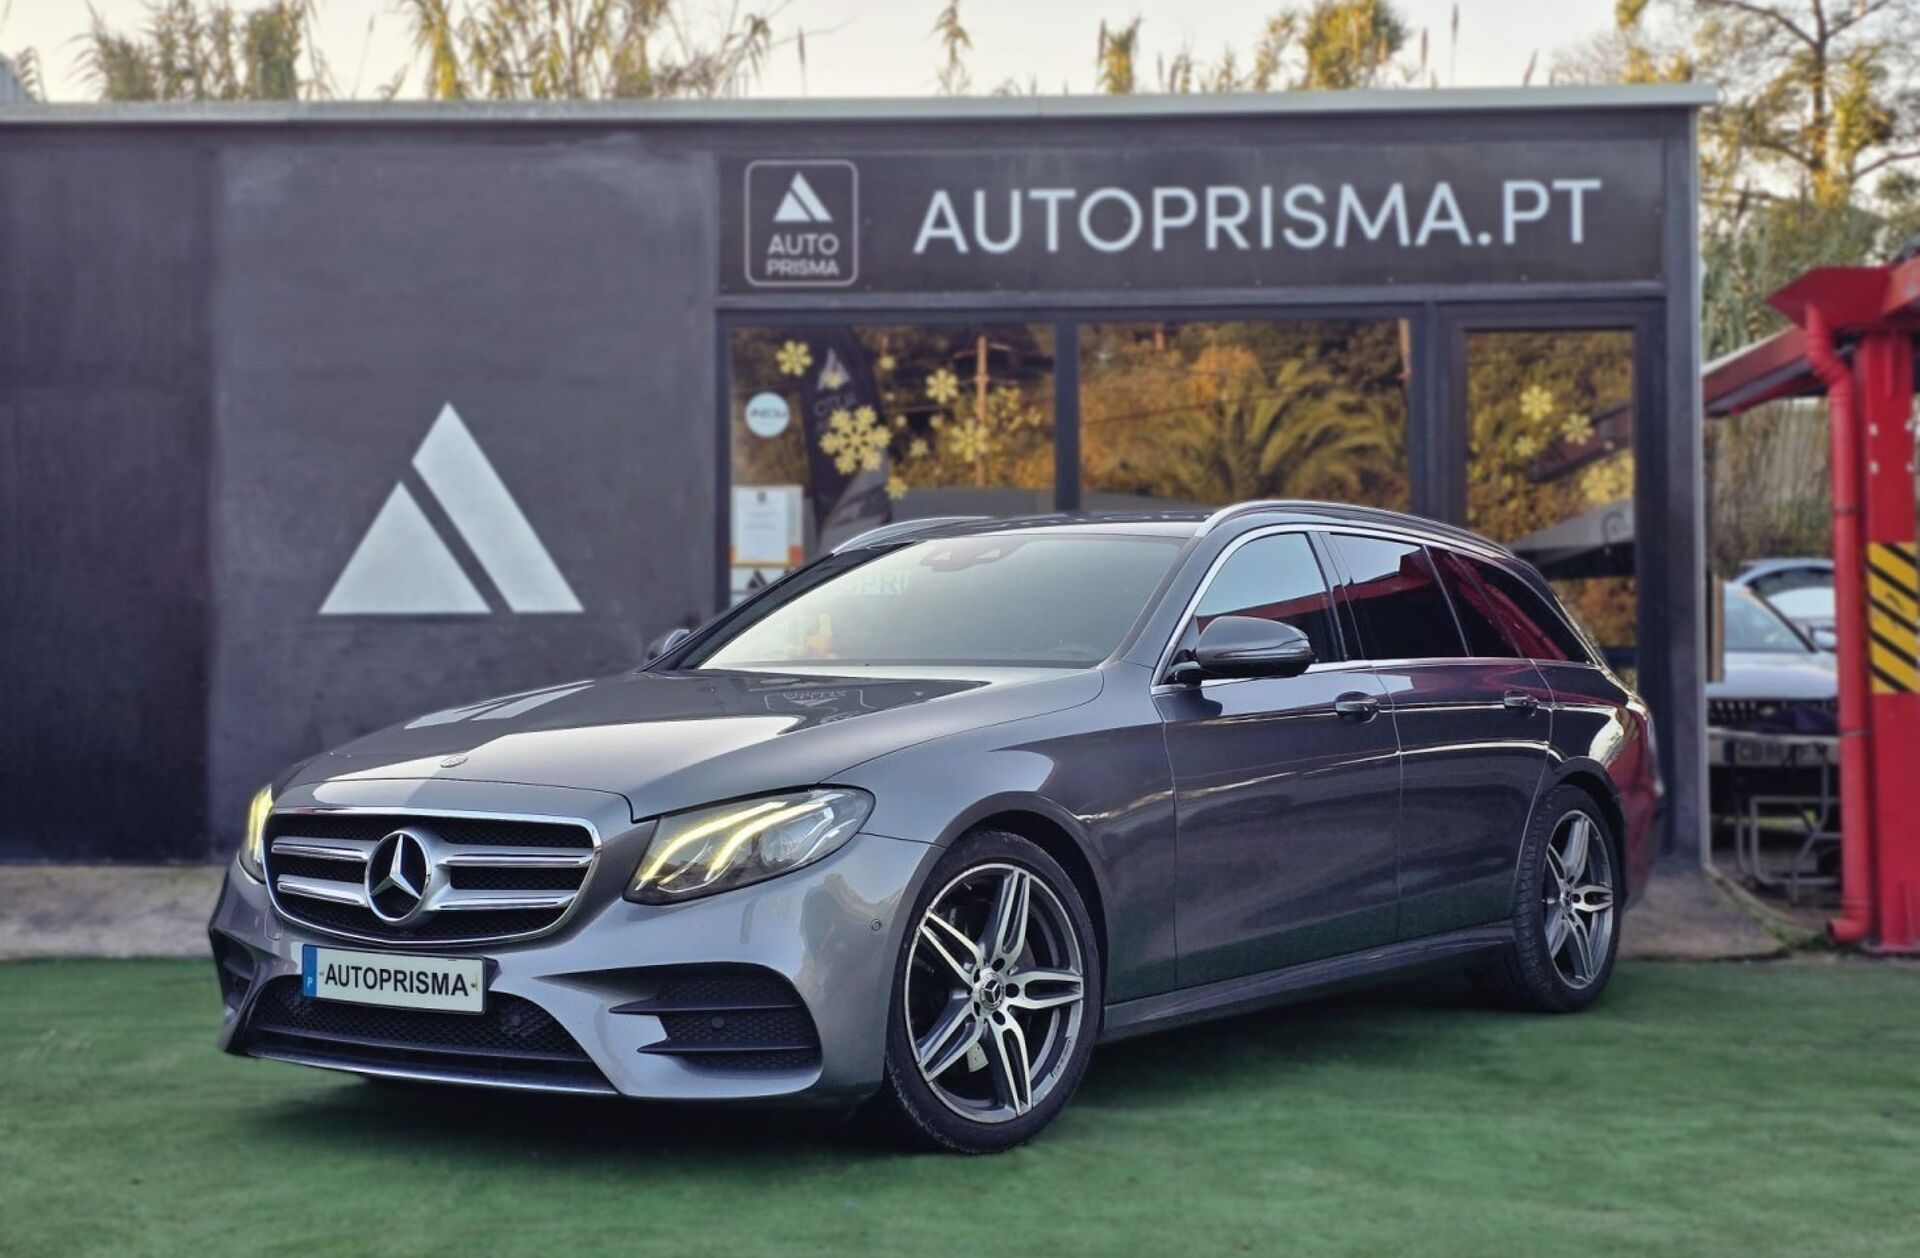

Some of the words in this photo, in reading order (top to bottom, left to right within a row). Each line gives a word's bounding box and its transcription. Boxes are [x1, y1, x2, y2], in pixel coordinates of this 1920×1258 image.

[913, 178, 1602, 253] AUTOPRISMA.PT
[767, 233, 840, 256] AUTO
[766, 258, 840, 276] PRISMA
[324, 962, 470, 997] AUTOPRISMA
